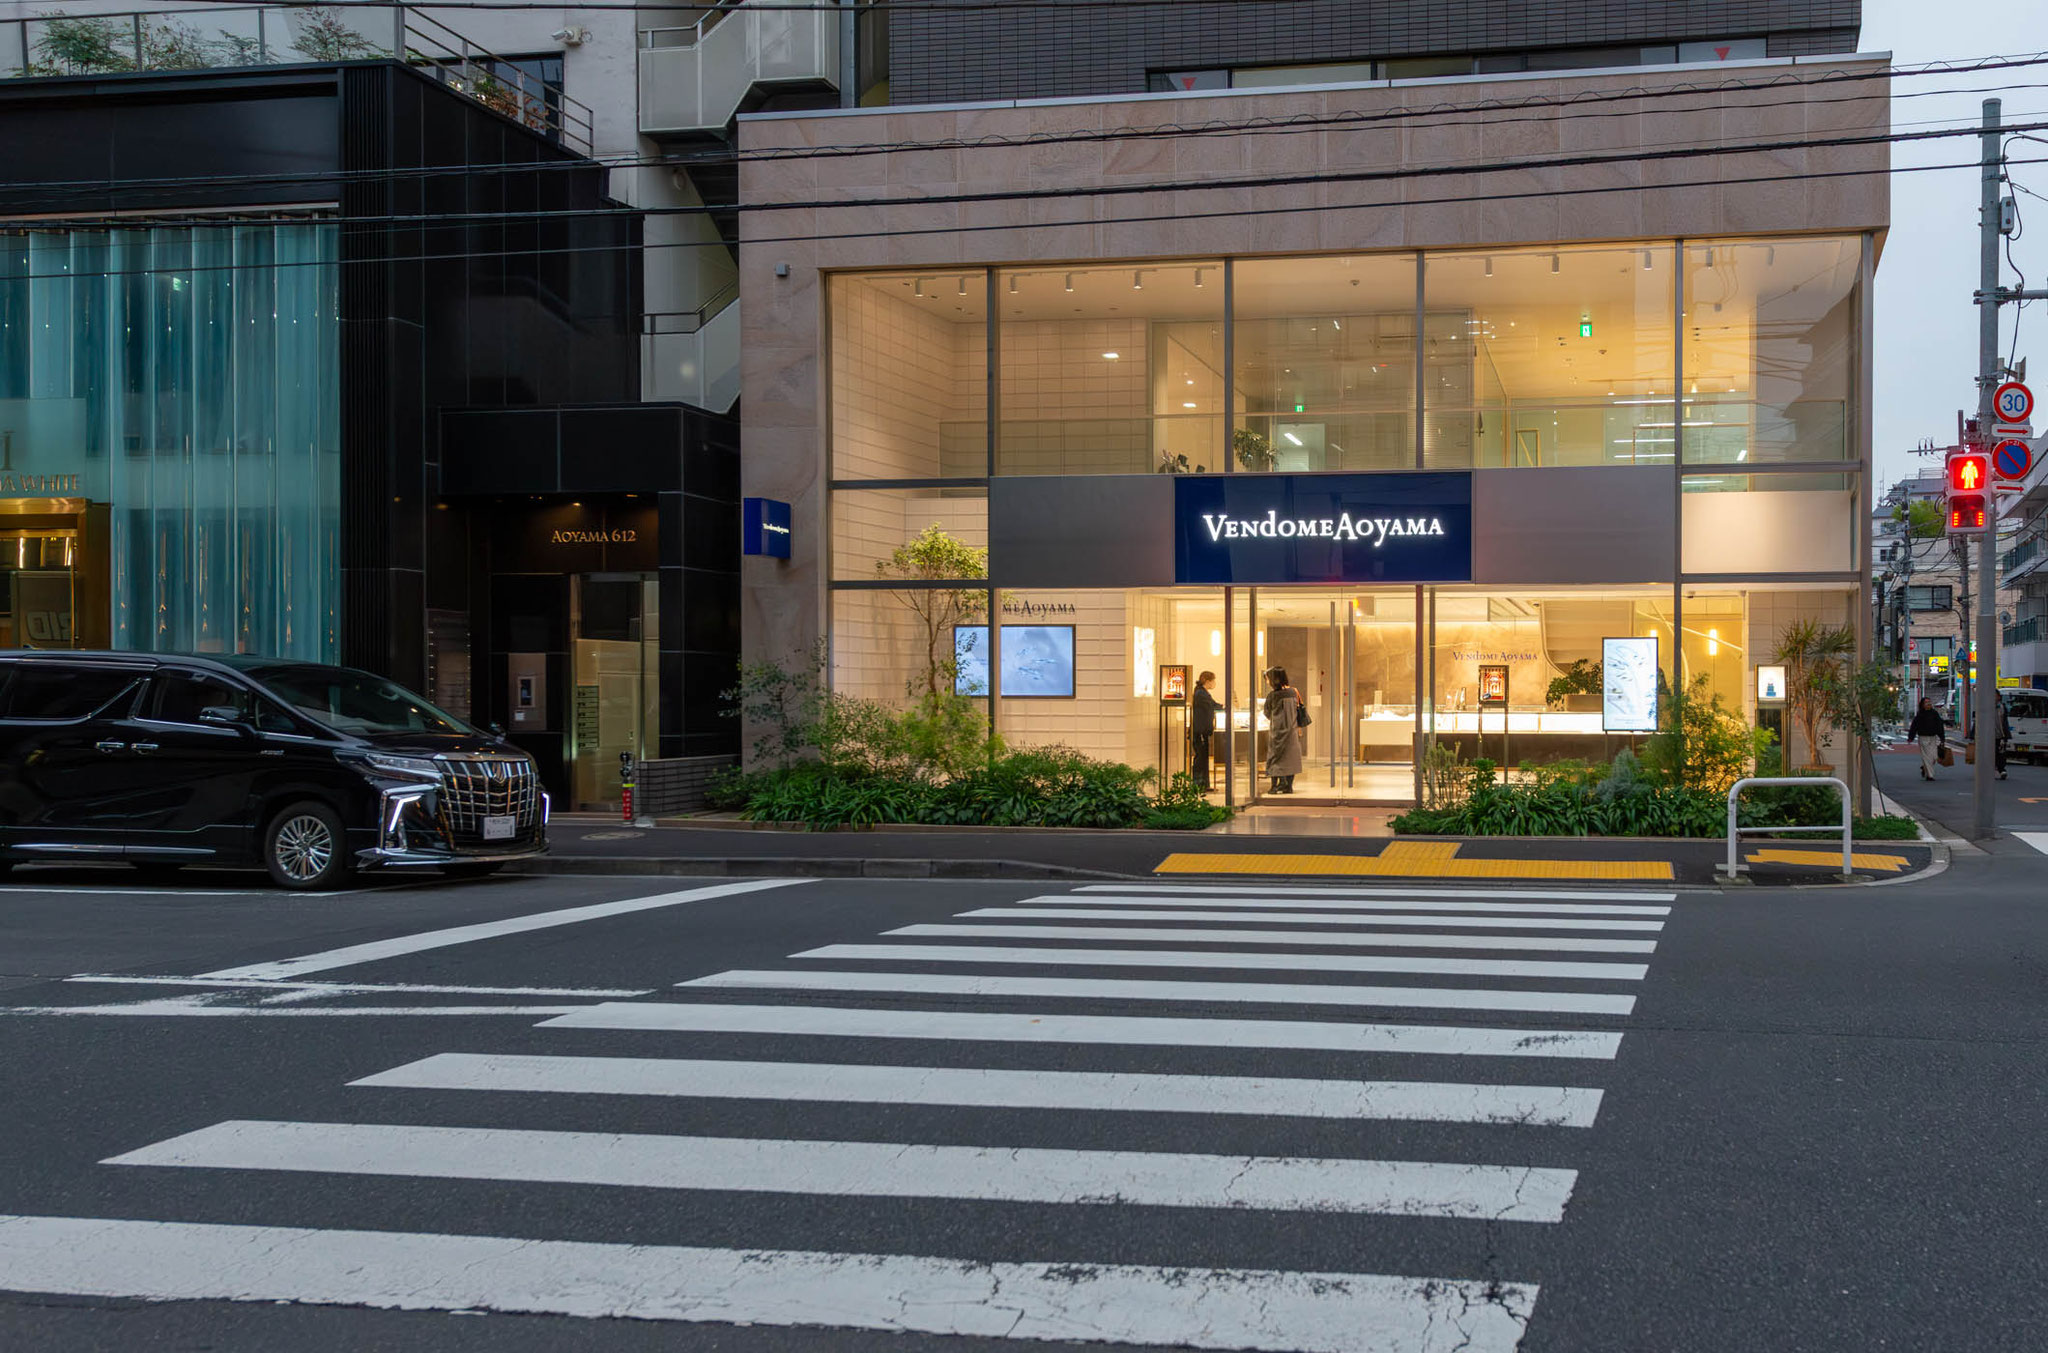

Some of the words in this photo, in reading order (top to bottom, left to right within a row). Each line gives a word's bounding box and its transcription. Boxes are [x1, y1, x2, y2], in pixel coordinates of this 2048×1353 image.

[2002, 393, 2025, 412] 30
[552, 530, 609, 543] AOYAMA
[611, 529, 636, 542] 612
